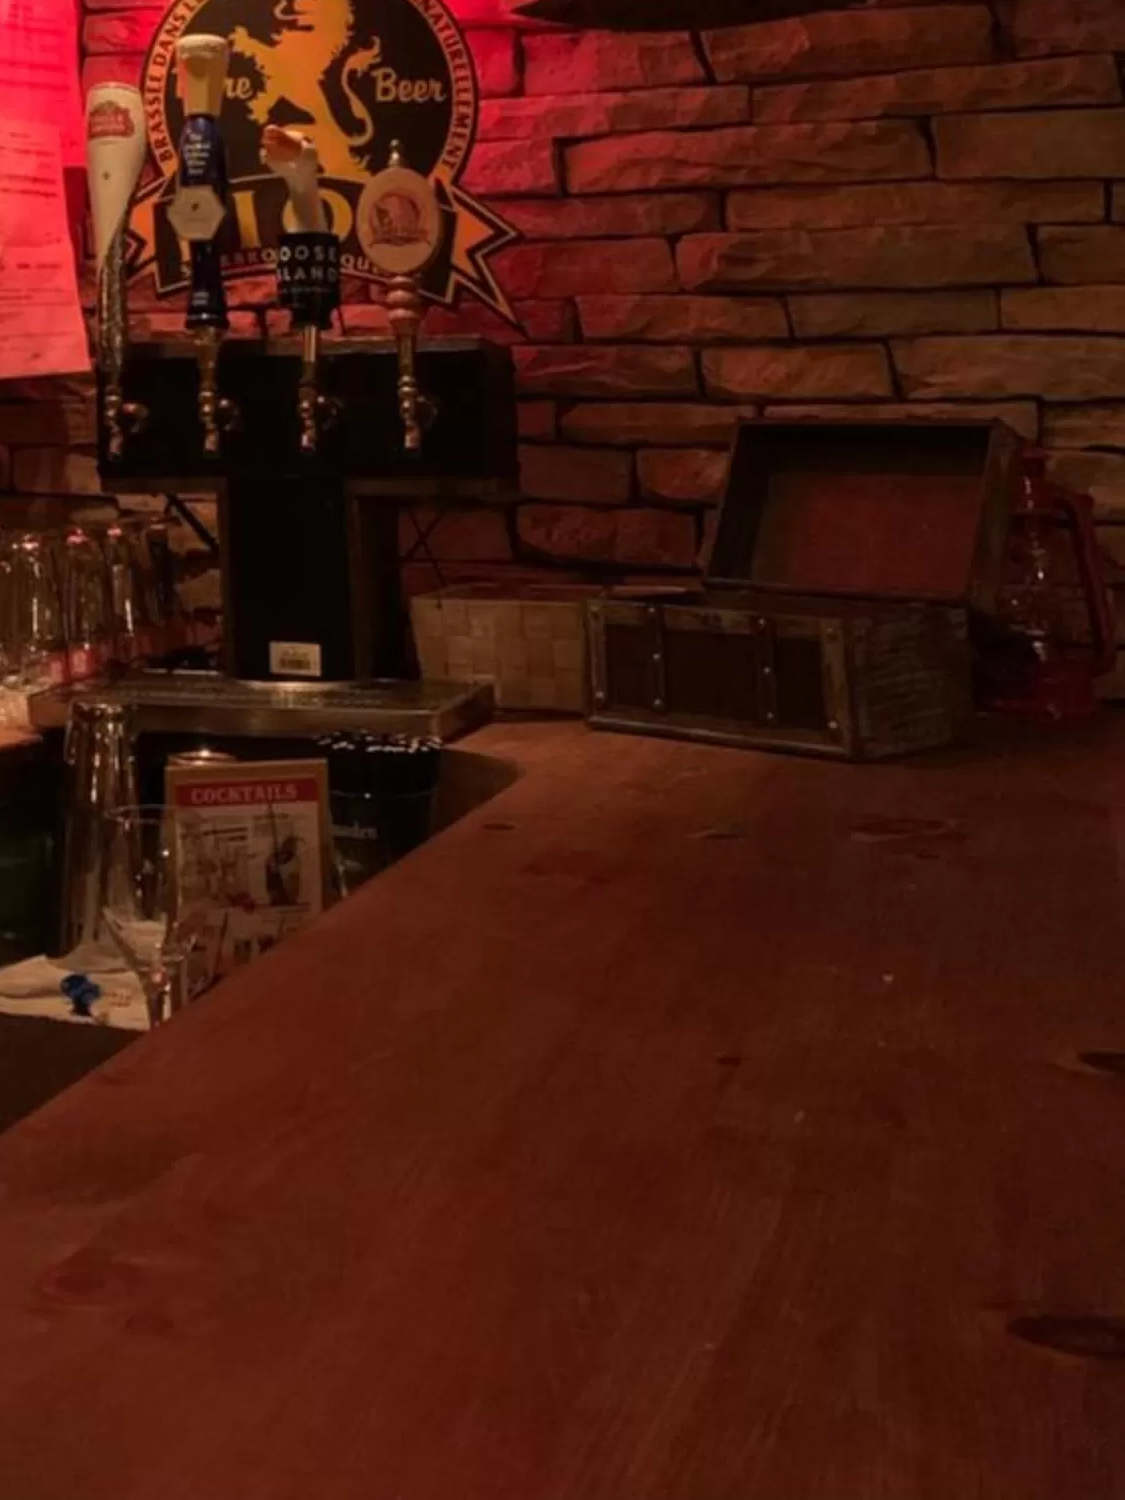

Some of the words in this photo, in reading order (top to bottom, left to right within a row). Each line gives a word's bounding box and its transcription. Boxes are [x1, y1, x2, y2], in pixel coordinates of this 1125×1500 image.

[154, 15, 186, 68] DANS
[370, 67, 447, 103] Beer
[190, 783, 299, 805] COCKTAILS
